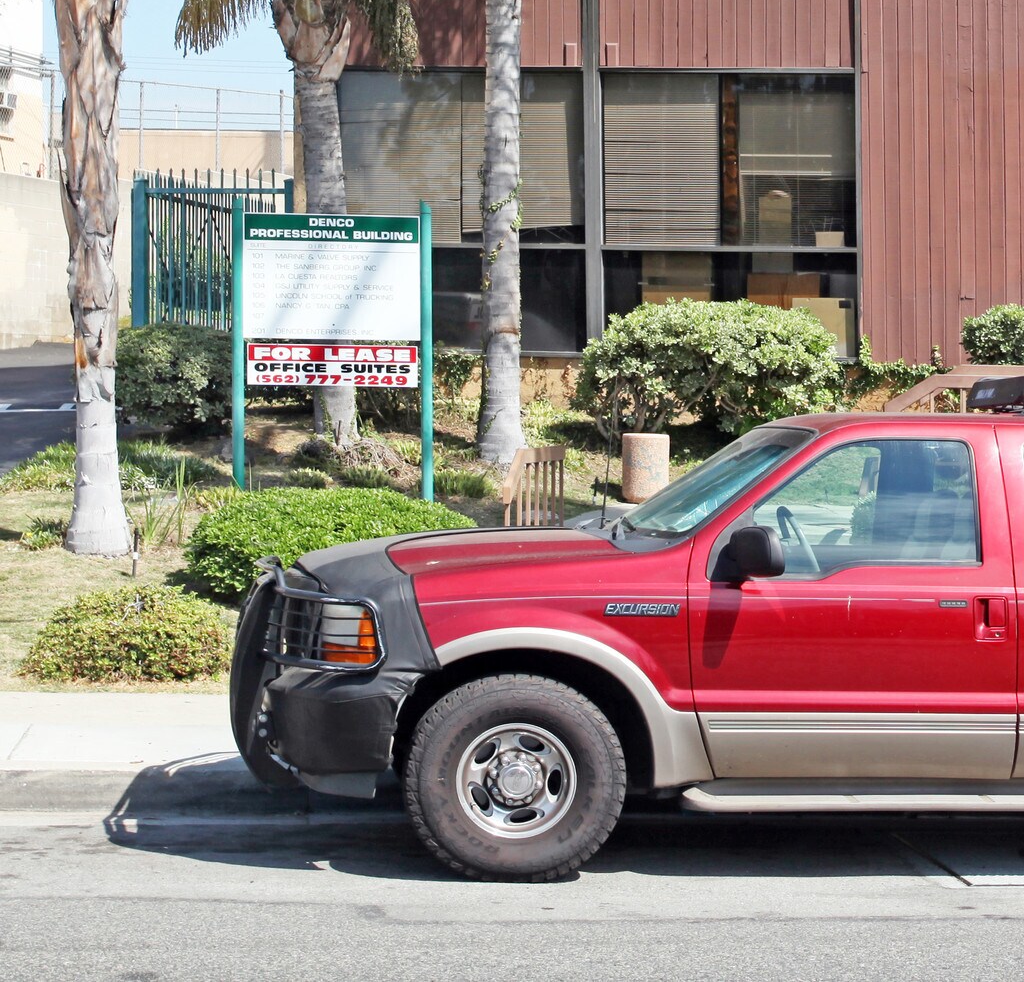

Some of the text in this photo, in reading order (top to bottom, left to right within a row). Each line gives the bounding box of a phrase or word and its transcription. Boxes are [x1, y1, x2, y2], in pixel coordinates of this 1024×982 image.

[309, 218, 354, 227] DENCO
[250, 229, 413, 240] PROFESSIONAL BUILDING
[254, 347, 410, 362] FOR LEASE
[254, 363, 410, 374] OFFICE SUITES
[256, 375, 407, 385] (562) 777-2249
[604, 603, 681, 615] EXCURSION
